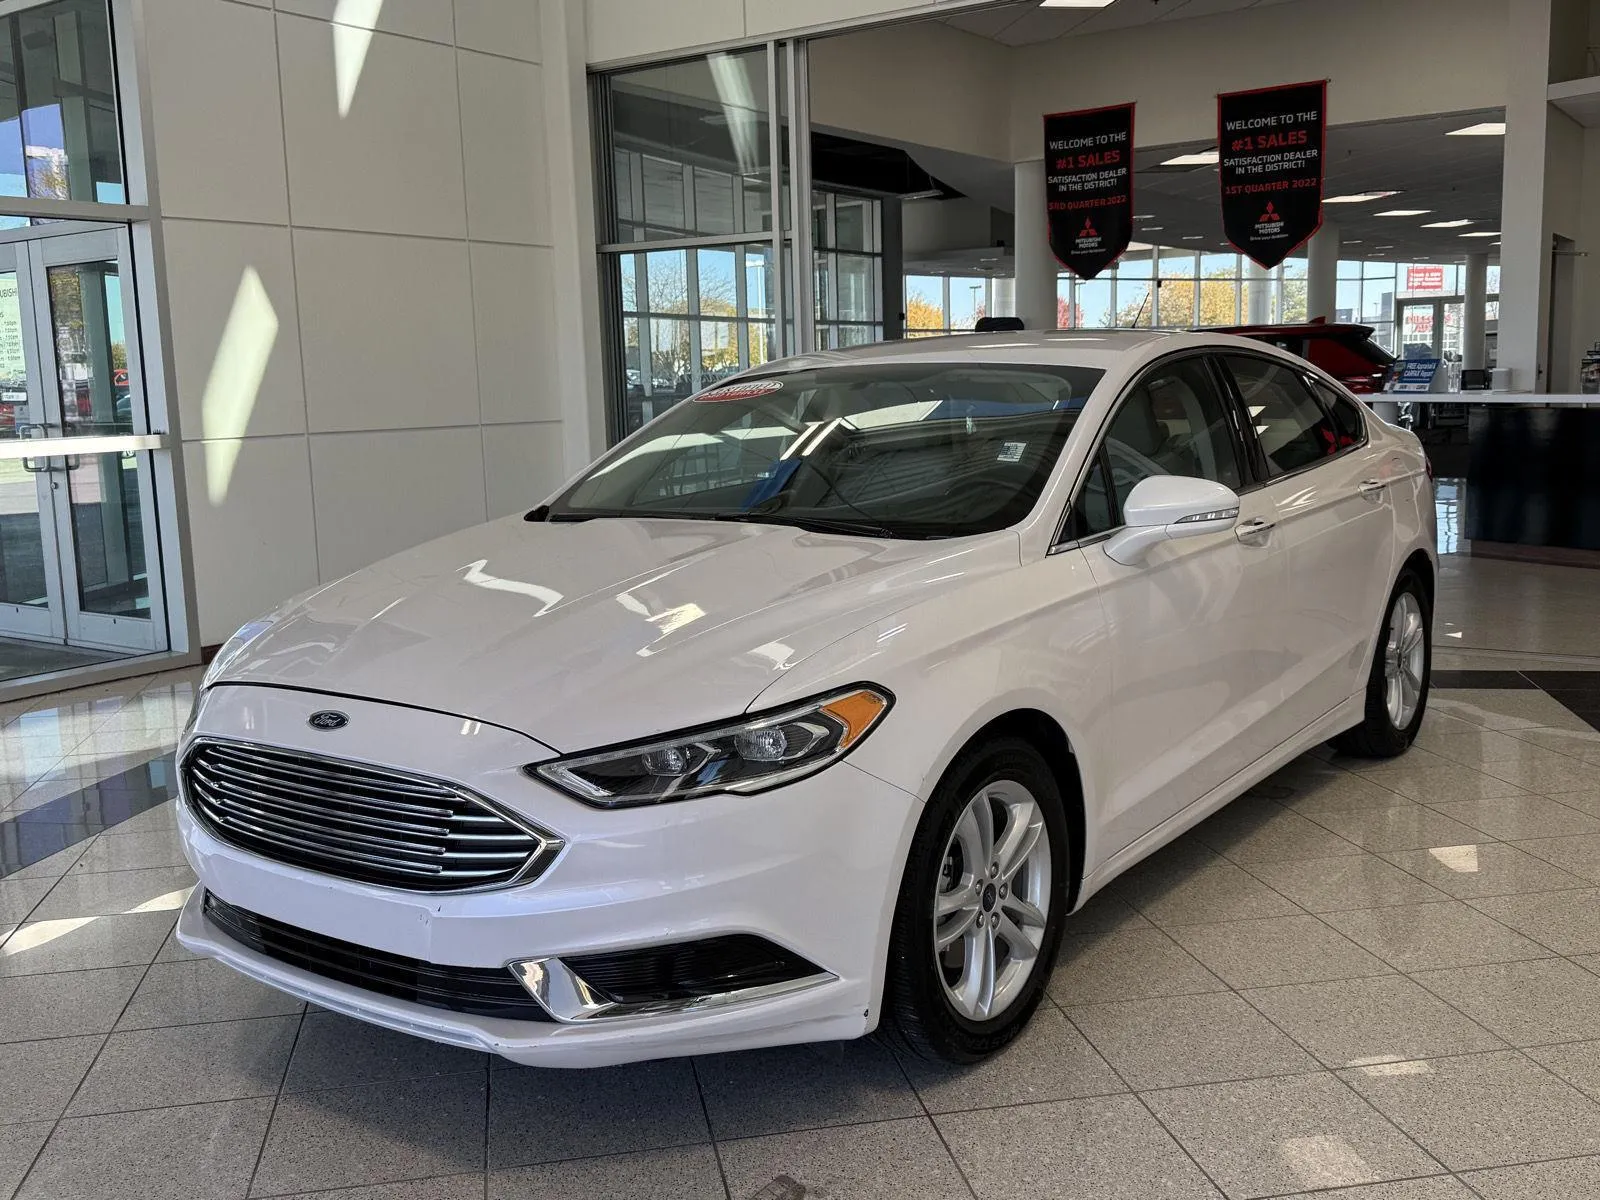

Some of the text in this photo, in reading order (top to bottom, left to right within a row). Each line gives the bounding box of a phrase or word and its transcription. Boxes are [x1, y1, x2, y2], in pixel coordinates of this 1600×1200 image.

[1226, 111, 1318, 131] WELCOME TO THE
[1050, 131, 1127, 150] WELCOME TO THE
[1231, 131, 1308, 151] #1 SALES
[1056, 150, 1121, 169] #1 SALES
[1223, 149, 1318, 167] SATISFACTION DEALER
[1048, 167, 1127, 184] SATISFACTION DEALER
[1235, 160, 1306, 175] IN THE DISTRICT!
[1058, 178, 1117, 192] IN THE DISTRICT!
[1225, 177, 1317, 195] 1ST QUARTER 2022
[1067, 197, 1107, 210] QUARTER
[1258, 226, 1281, 235] MOTORS
